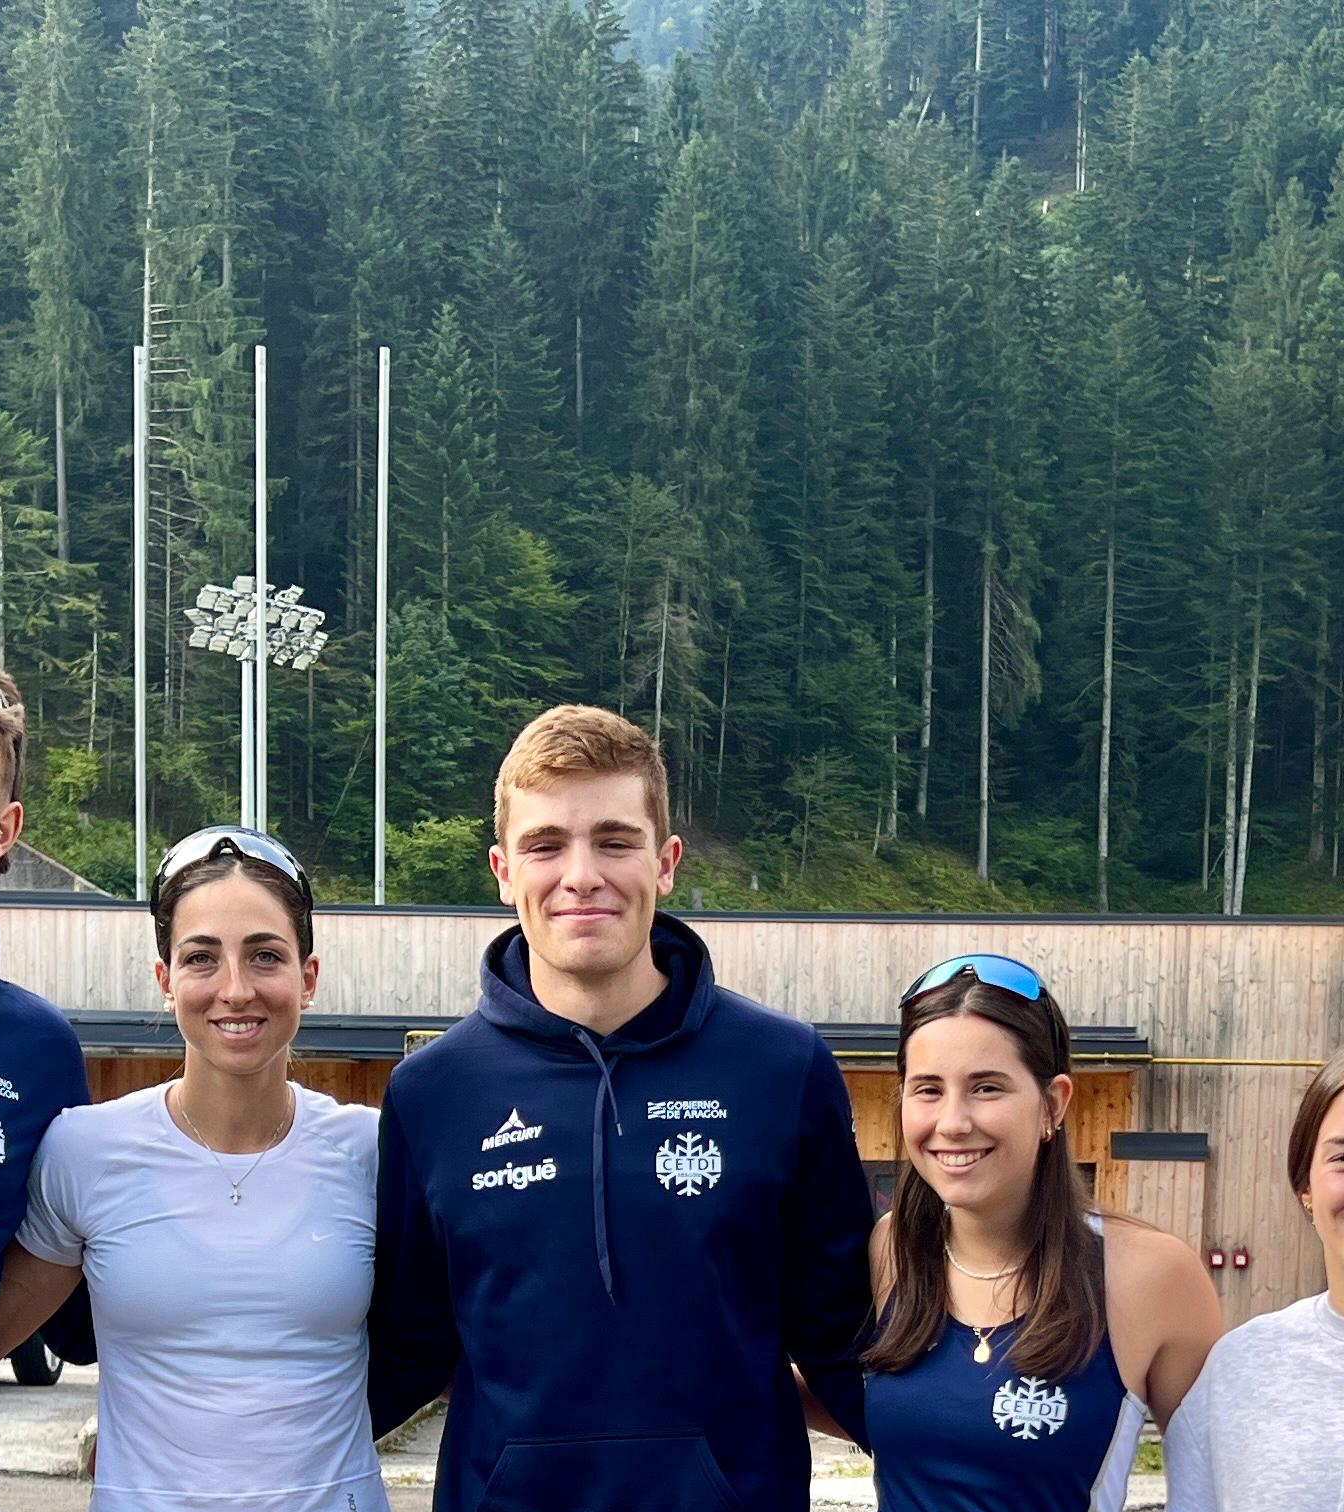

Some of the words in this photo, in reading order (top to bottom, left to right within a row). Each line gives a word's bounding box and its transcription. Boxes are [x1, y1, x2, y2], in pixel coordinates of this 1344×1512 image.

[666, 1100, 720, 1110] GOBIERNO
[666, 1109, 681, 1119] DE
[481, 1125, 543, 1152] MERCURY
[662, 1158, 715, 1171] CETDI
[1000, 1399, 1060, 1418] CETDI
